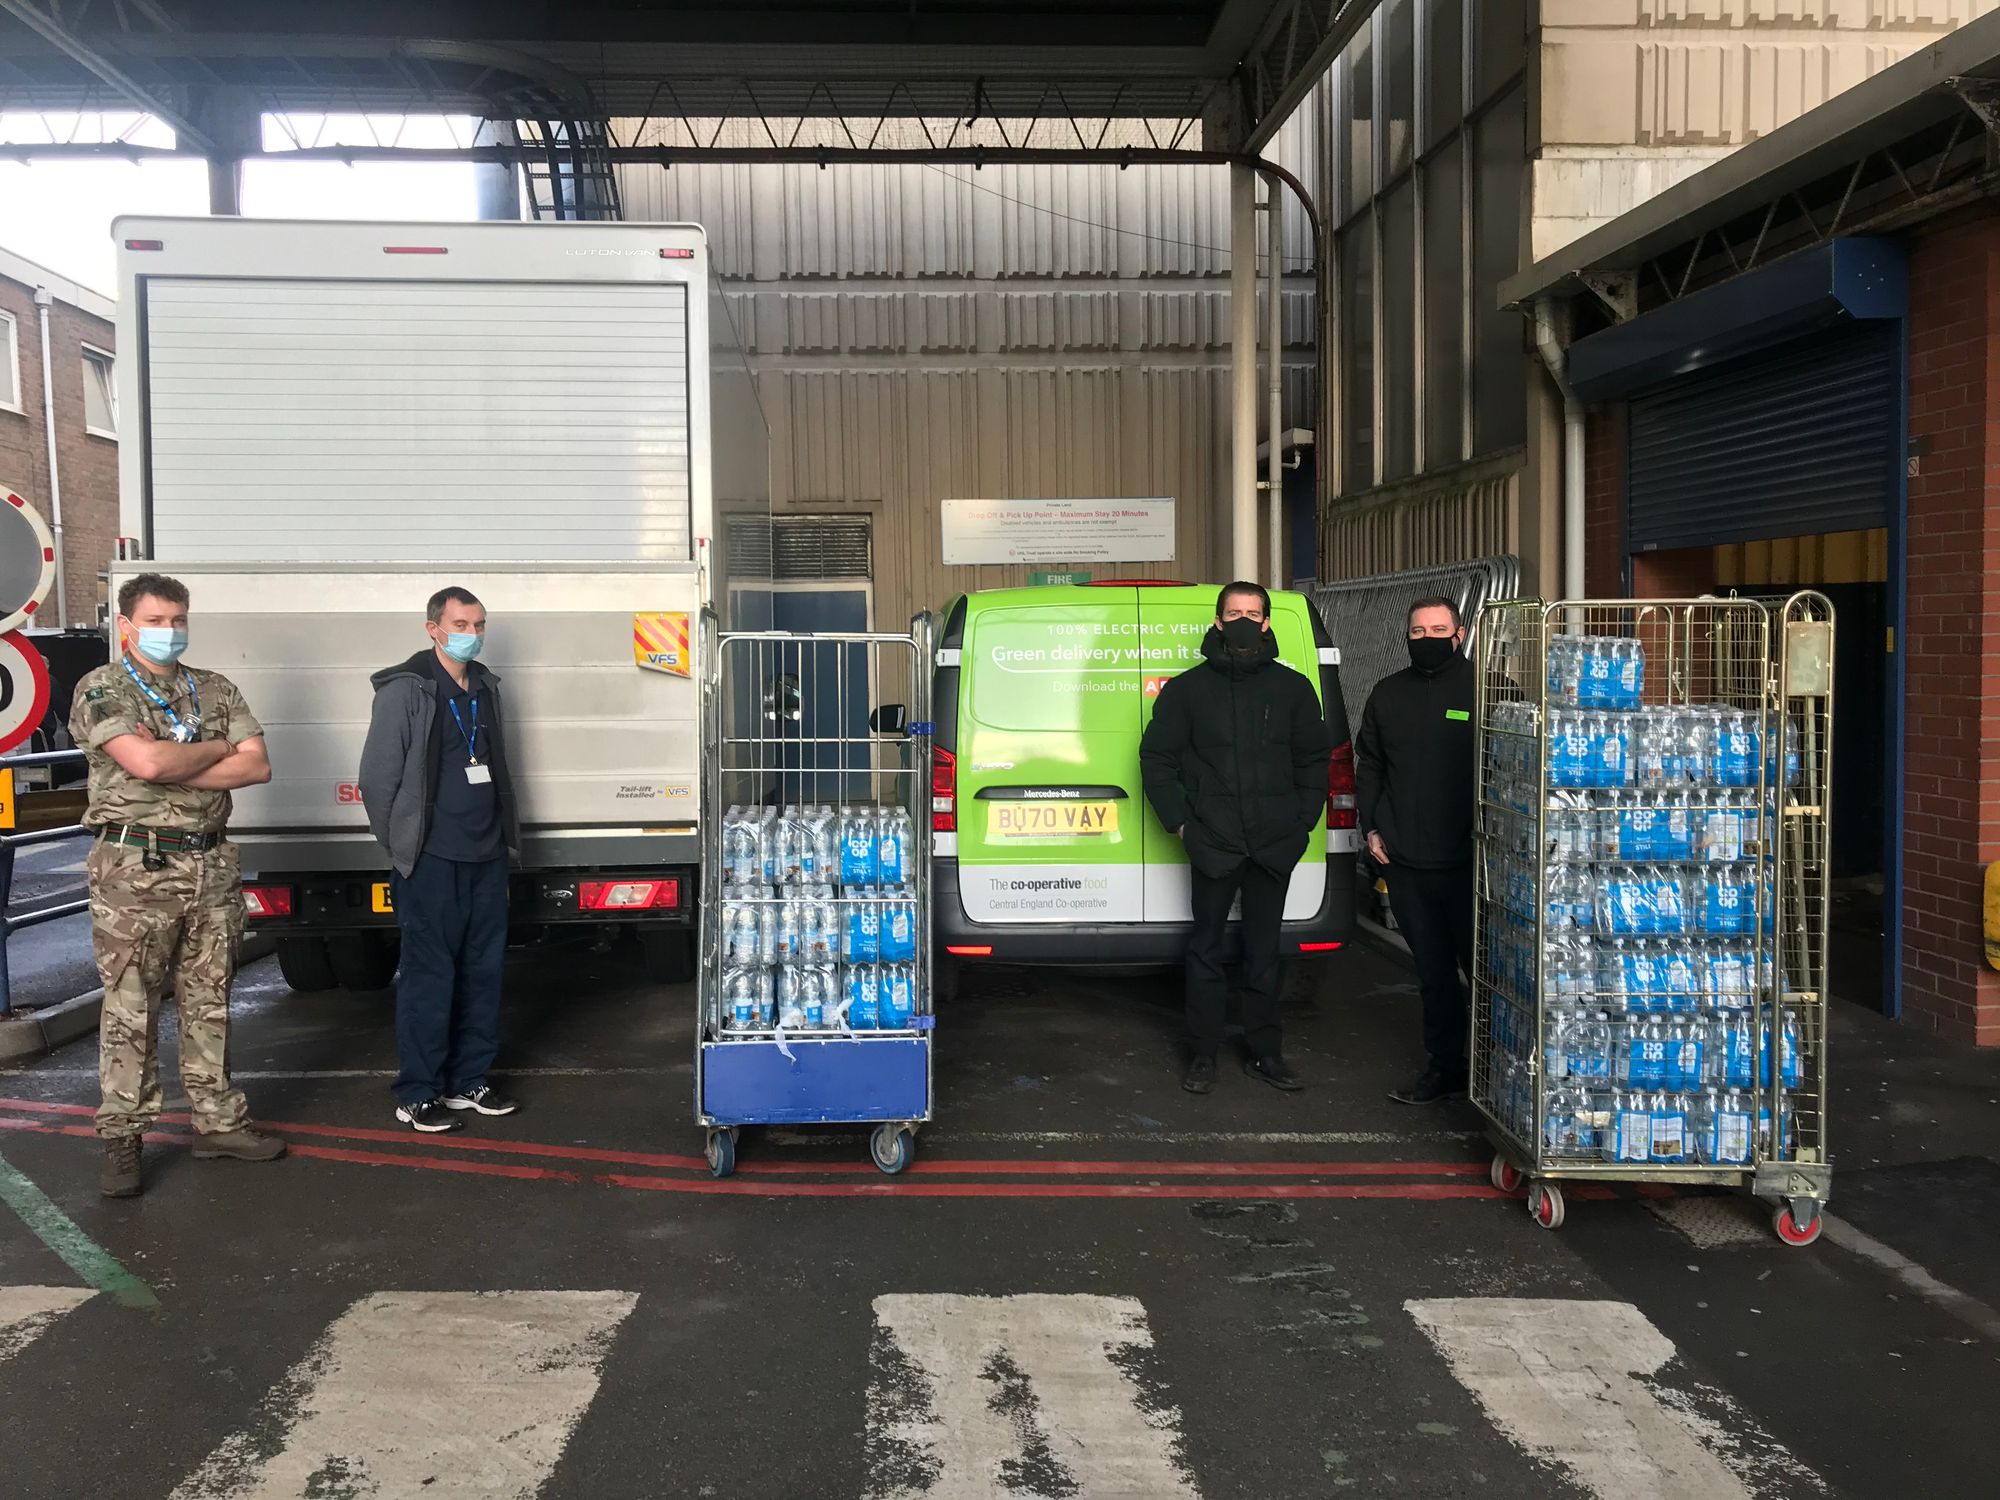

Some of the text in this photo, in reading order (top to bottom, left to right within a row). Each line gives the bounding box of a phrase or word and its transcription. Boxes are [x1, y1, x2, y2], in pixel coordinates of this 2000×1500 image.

[968, 512, 985, 520] Drop
[987, 511, 998, 519] Off
[1023, 511, 1033, 519] Up
[1095, 511, 1110, 519] Stay
[1047, 574, 1072, 585] FIRE
[1047, 624, 1088, 636] 100%
[1093, 623, 1165, 635] ELECTRIC
[647, 653, 677, 665] VFS
[991, 645, 1046, 661] Green
[1050, 644, 1121, 664] delivery
[1124, 643, 1173, 660] when
[1177, 644, 1189, 660] it
[1053, 680, 1116, 693] Download
[1120, 680, 1139, 692] the
[668, 787, 689, 796] VFS
[1023, 789, 1080, 799] Mercedes-Benz
[998, 806, 1107, 829] BU70 VAY
[1635, 843, 1651, 851] STILL
[990, 877, 1108, 892] The co-operative food
[989, 898, 1108, 910] Central England Co-operative
